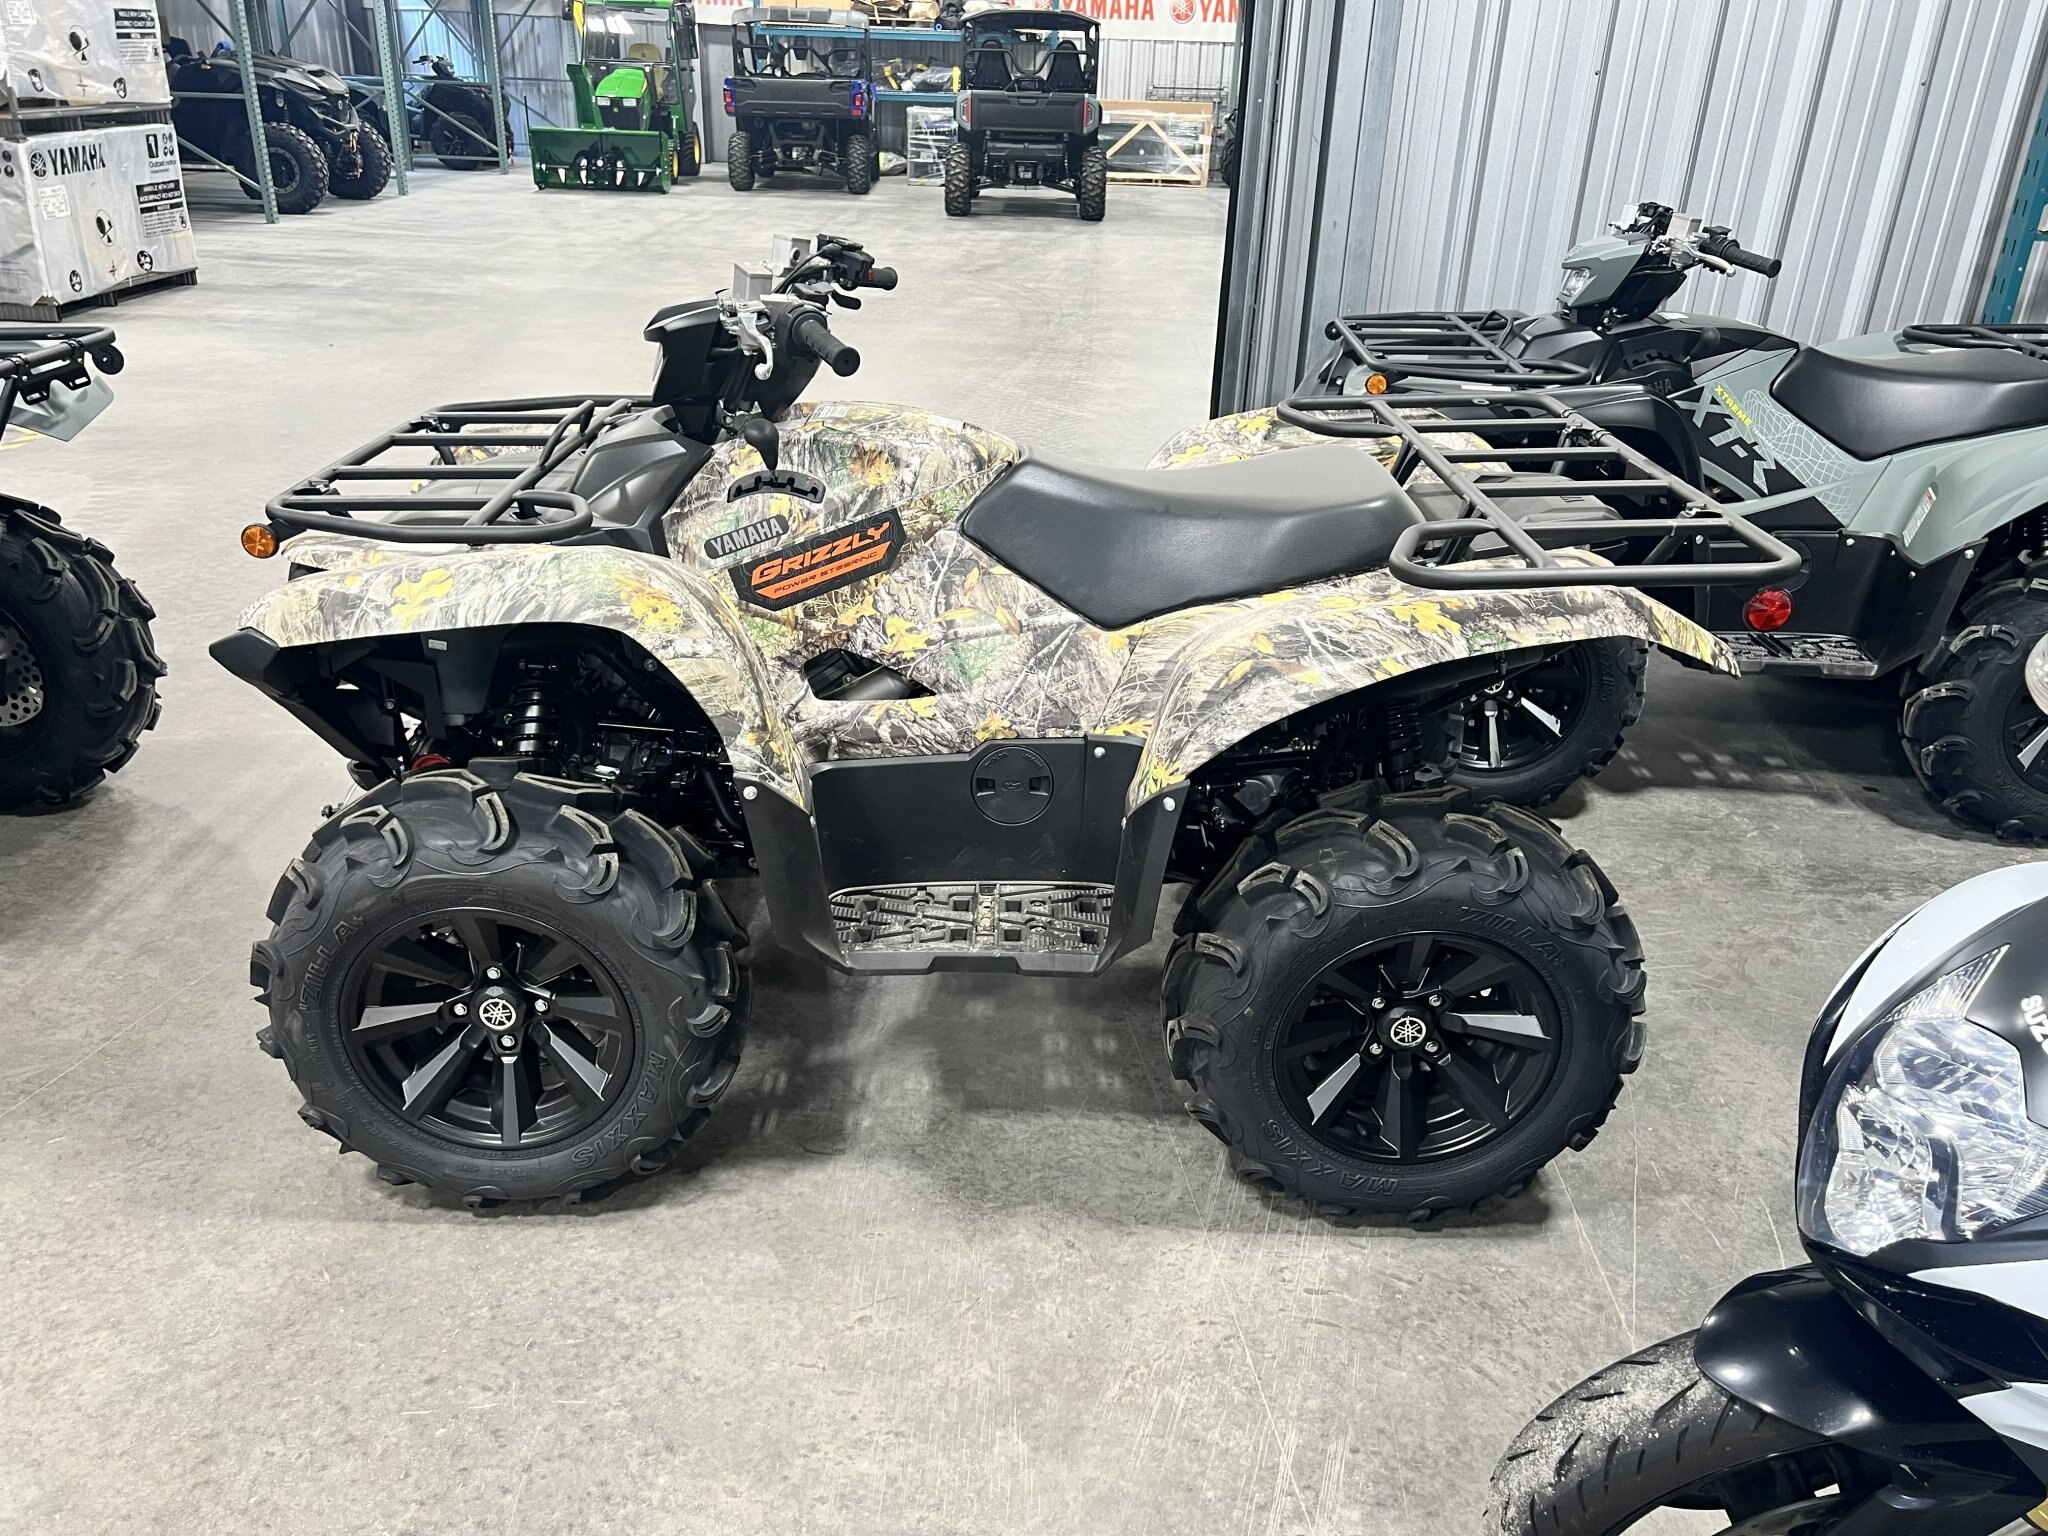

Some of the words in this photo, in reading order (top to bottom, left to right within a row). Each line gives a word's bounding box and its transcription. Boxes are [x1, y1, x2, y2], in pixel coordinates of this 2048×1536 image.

[1062, 0, 1154, 20] YAMAHA
[1200, 0, 1239, 23] YAM
[48, 143, 106, 176] YAMAHA
[1714, 384, 1753, 427] XTREME
[710, 518, 784, 557] YAMAHA
[751, 521, 890, 587] GRIZZLY
[774, 574, 817, 594] POWER
[820, 550, 878, 577] STEERING
[571, 1050, 667, 1169] MAXXIS
[1261, 1119, 1399, 1195] MAXXIS
